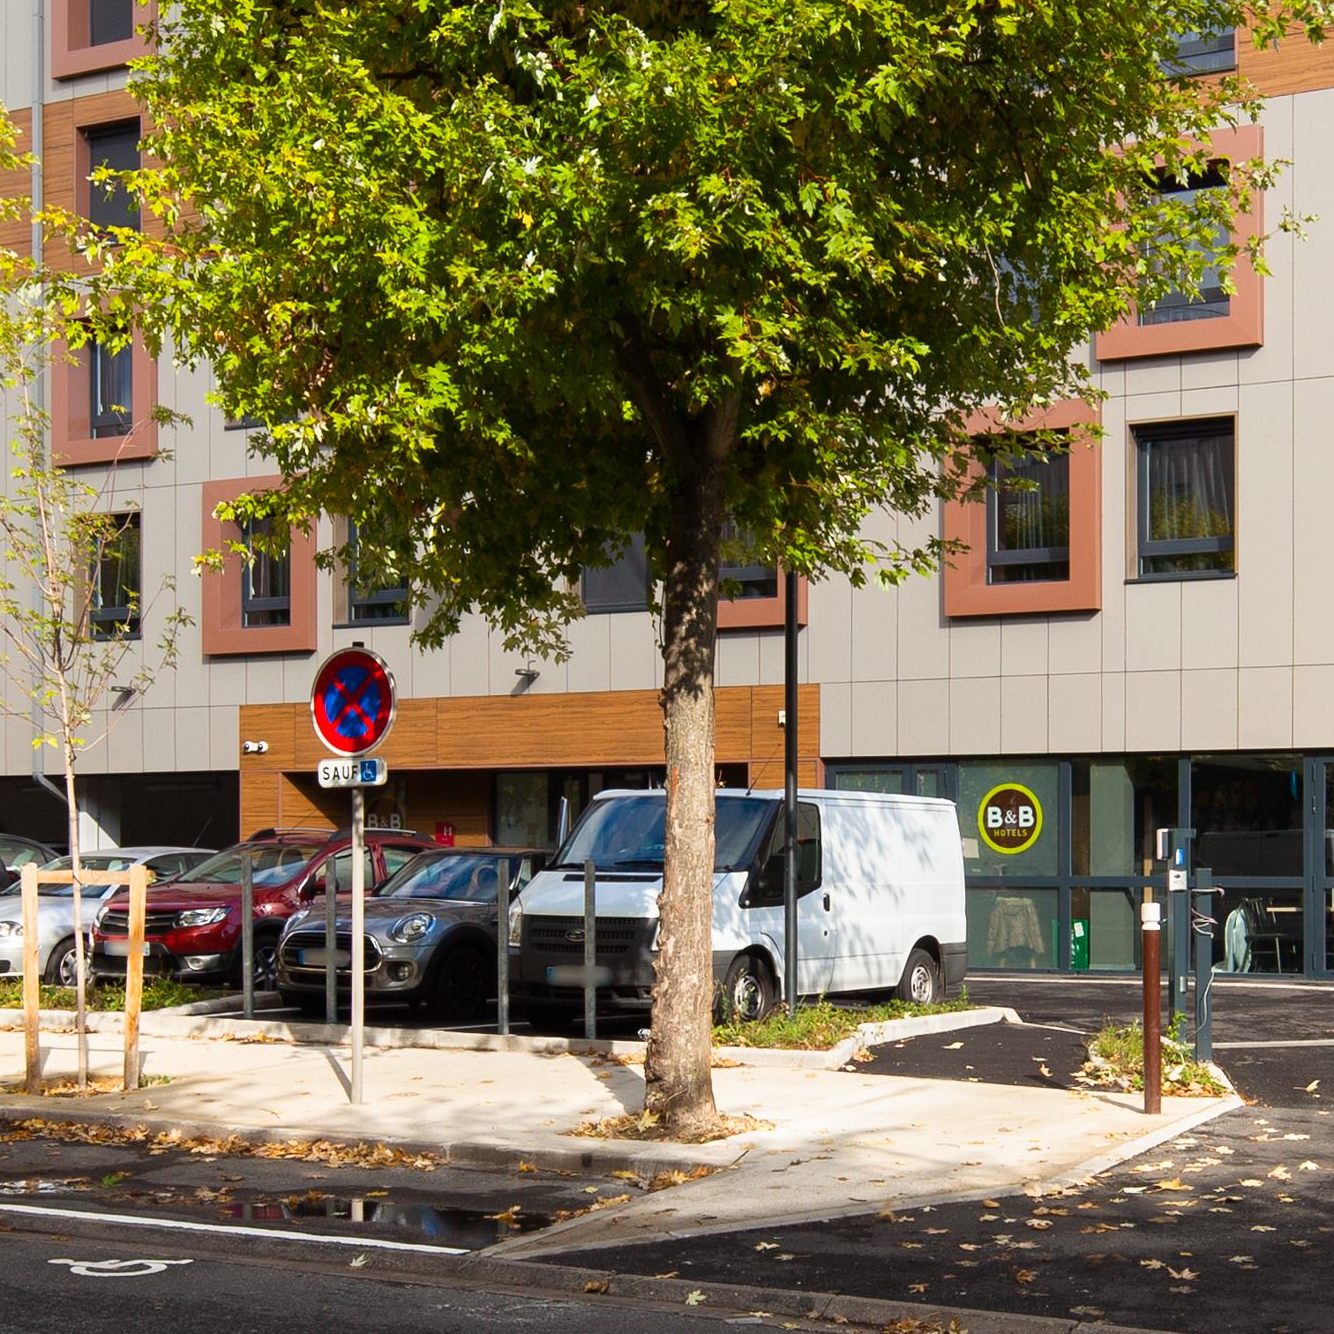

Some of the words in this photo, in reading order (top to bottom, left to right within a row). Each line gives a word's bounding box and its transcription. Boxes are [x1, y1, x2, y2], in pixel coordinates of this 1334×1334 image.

[322, 765, 359, 781] SAUF
[367, 813, 402, 829] B&B
[987, 805, 1035, 829] B&B
[443, 826, 452, 836] H
[993, 828, 1028, 837] HOTELS
